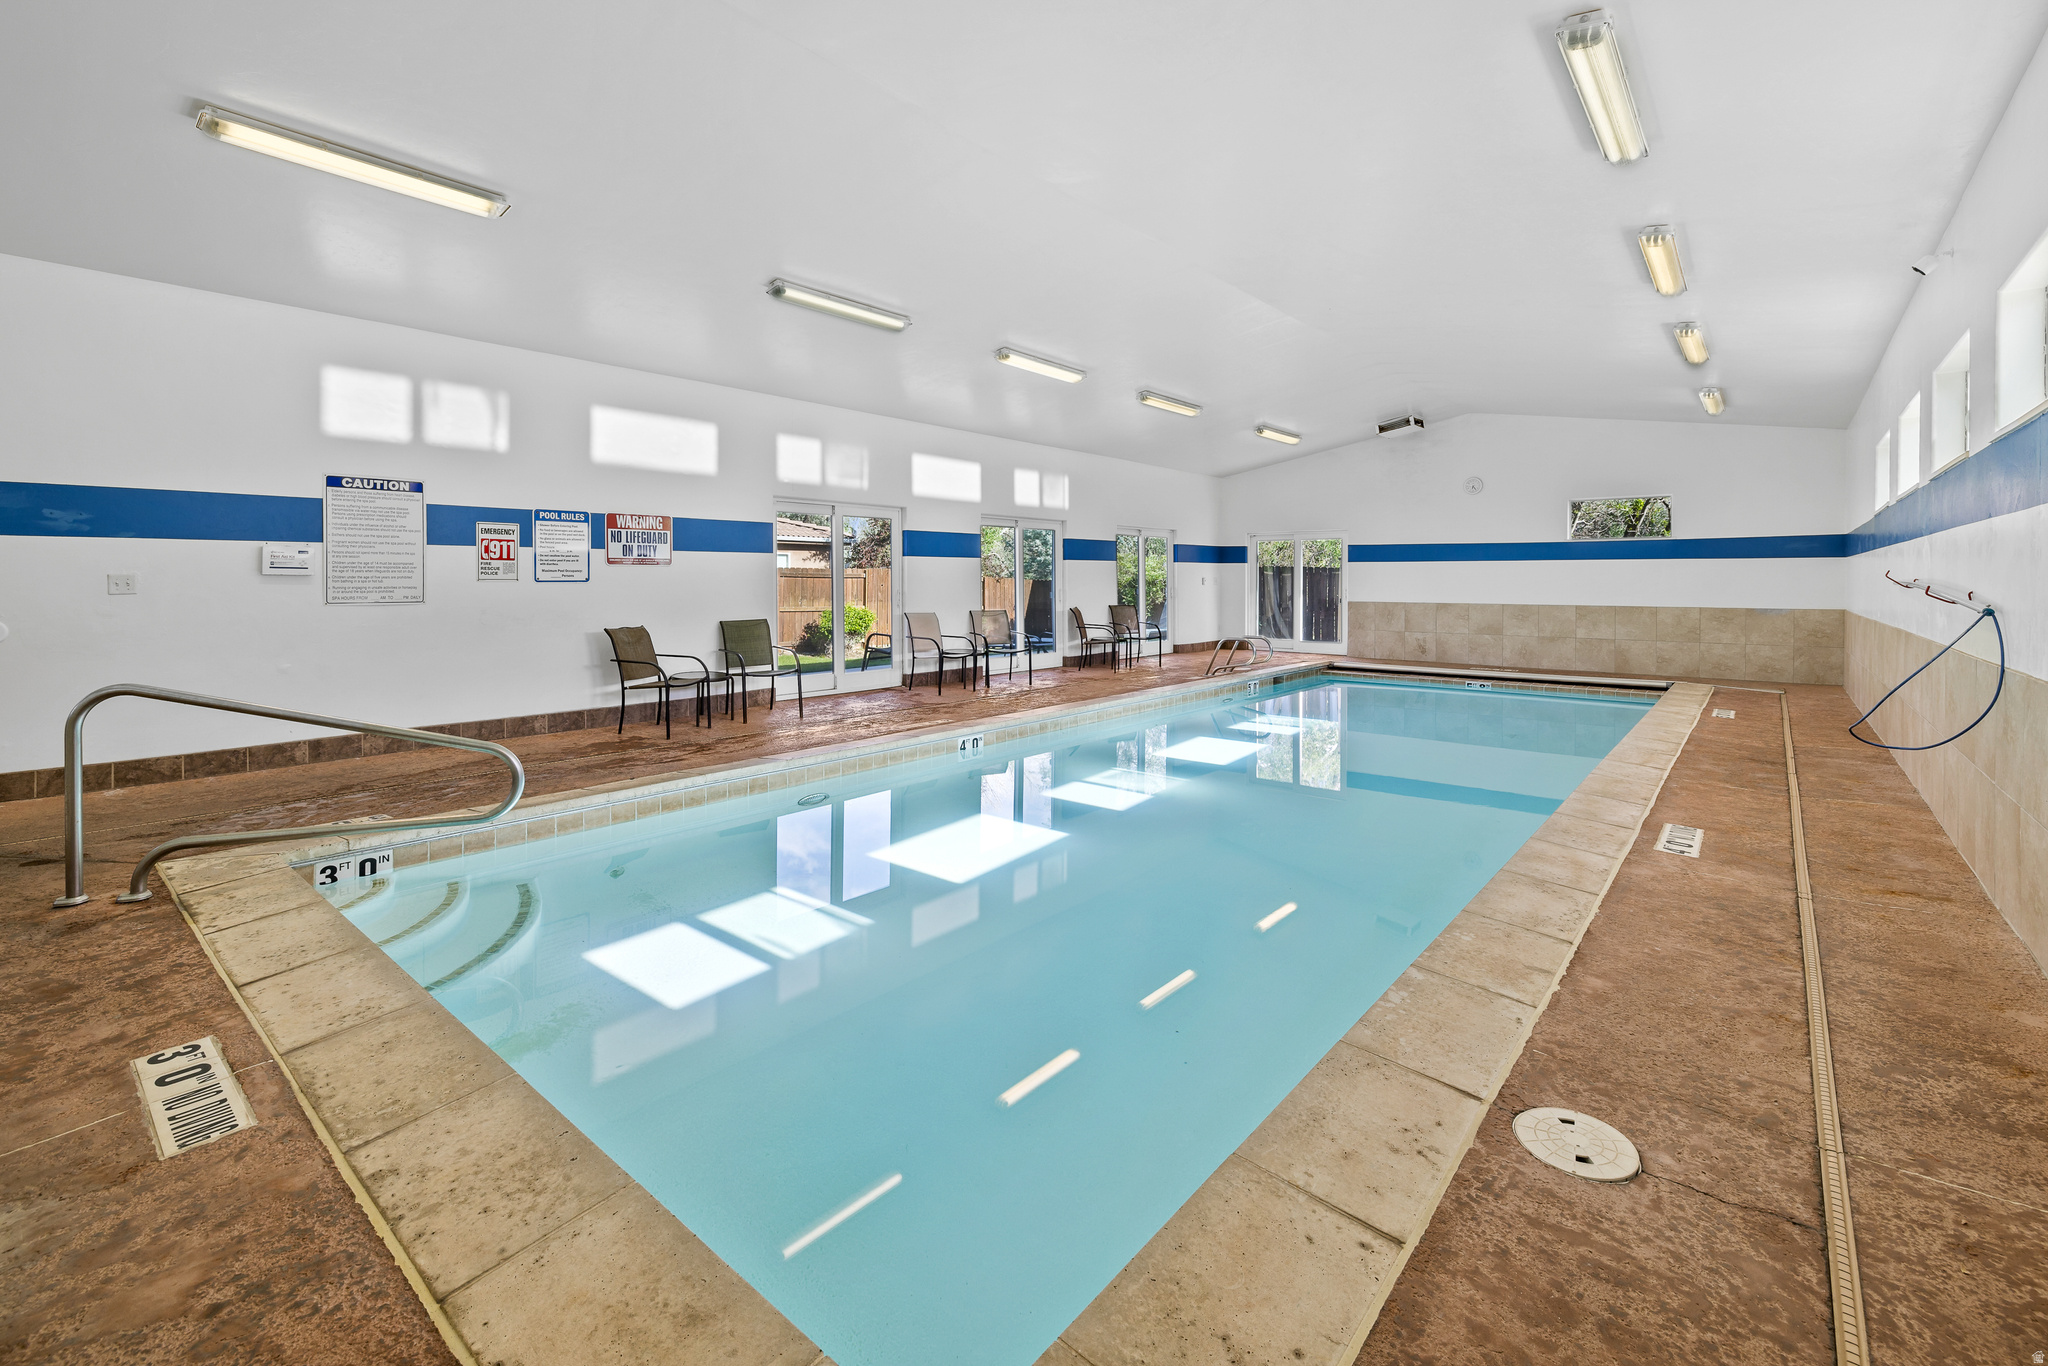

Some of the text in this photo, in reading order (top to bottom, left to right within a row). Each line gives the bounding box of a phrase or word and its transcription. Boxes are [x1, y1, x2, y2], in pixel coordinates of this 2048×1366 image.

[341, 477, 410, 491] CAUTION
[540, 511, 585, 521] POOL RULES
[616, 514, 663, 530] WARNING
[611, 530, 668, 544] NO LIFEGUARD
[490, 540, 515, 559] 911
[622, 544, 658, 557] ON DUTY
[319, 854, 389, 885] 3 FT 0 IN
[147, 1044, 239, 1149] 3 FT 0 IN NO DIVING
